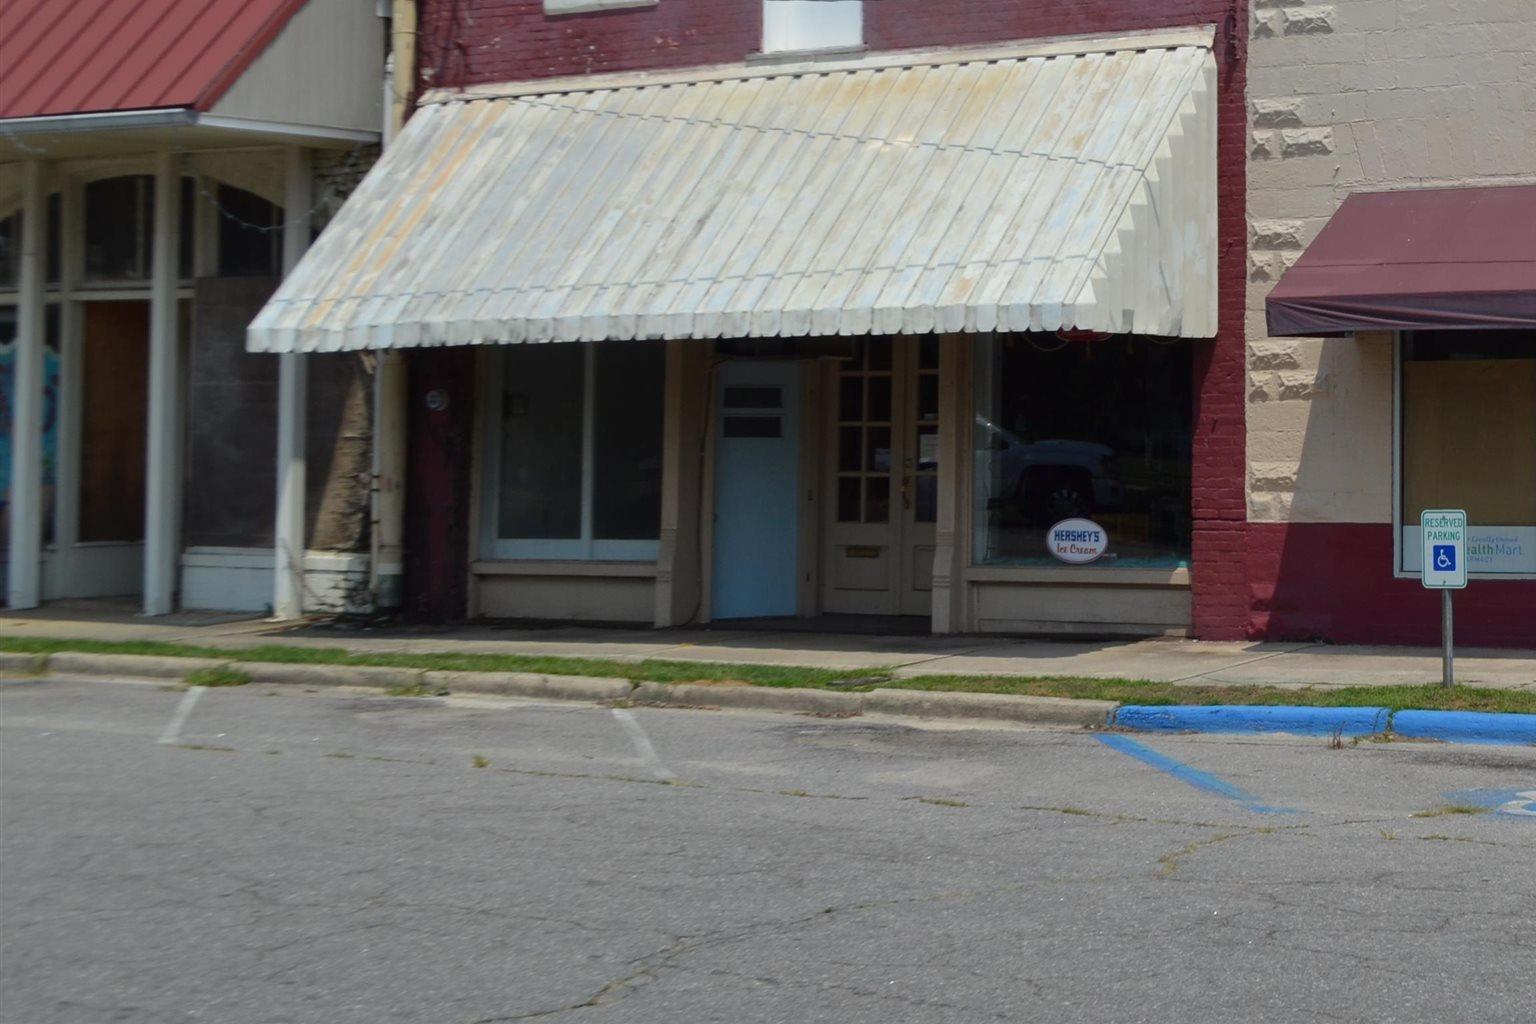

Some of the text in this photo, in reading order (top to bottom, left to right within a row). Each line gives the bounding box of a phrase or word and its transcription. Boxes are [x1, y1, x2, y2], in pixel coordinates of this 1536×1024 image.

[1424, 518, 1463, 528] RESERVED
[1054, 530, 1100, 542] HERSHEY'S
[1427, 531, 1461, 541] PARKING
